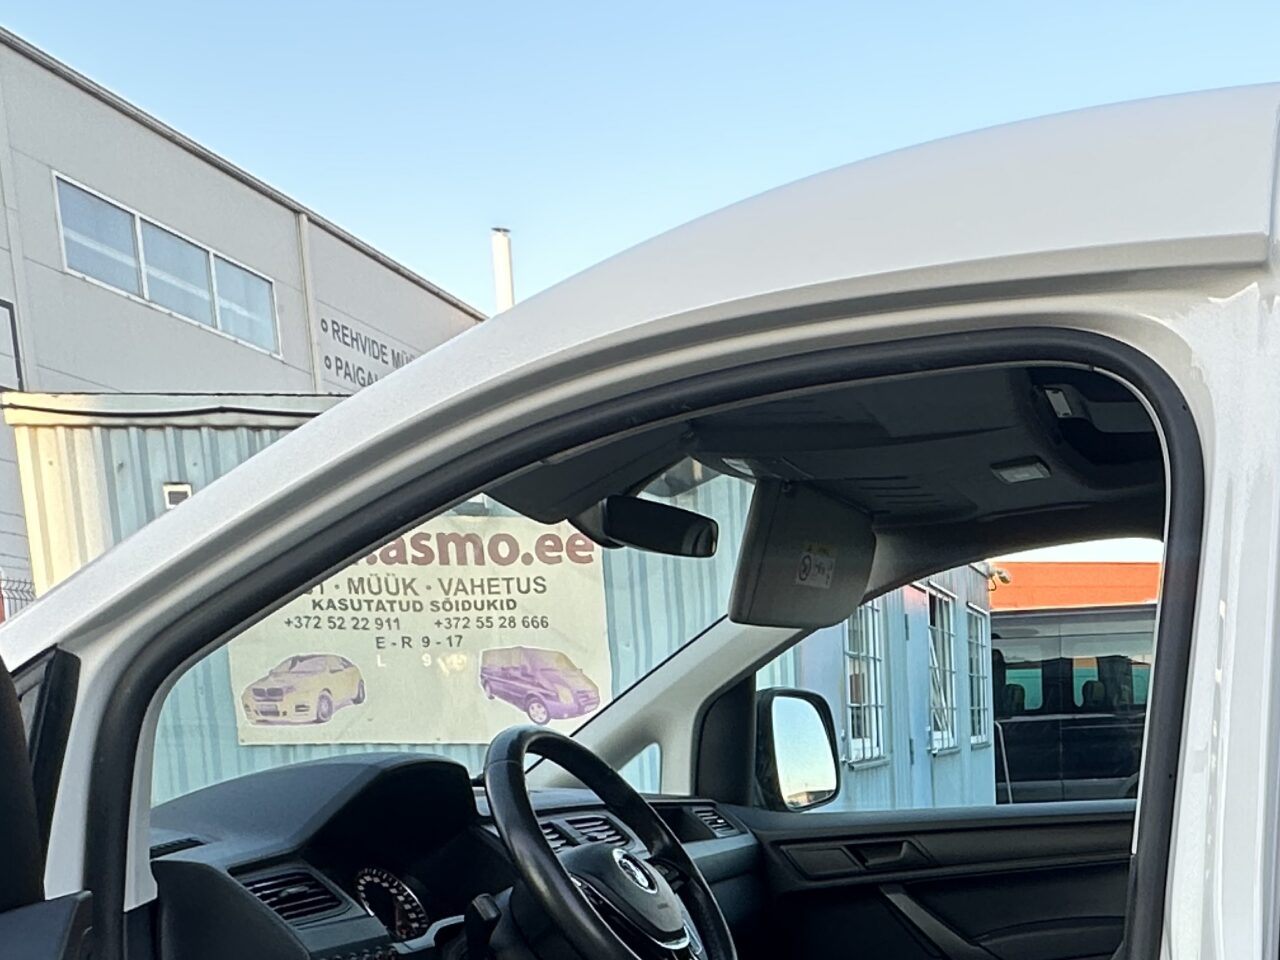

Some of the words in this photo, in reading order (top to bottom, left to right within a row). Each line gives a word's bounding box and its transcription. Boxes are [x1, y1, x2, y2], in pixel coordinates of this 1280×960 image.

[331, 320, 389, 365] REHVIDE
[353, 532, 595, 566] .asmo.ee
[347, 573, 419, 596] MÜÜK
[438, 576, 547, 596] VAHETUS
[312, 598, 424, 613] KASUTATUD
[430, 597, 517, 612] SÕIDUKID
[284, 615, 322, 629] +372
[327, 616, 347, 630] 52
[350, 617, 370, 631] 22
[374, 617, 400, 631] 911
[434, 616, 470, 629] +372
[475, 616, 494, 629] 55
[498, 615, 517, 629] 28
[521, 615, 549, 629] 666
[375, 636, 386, 650] E
[401, 635, 413, 649] R
[421, 635, 431, 648] 9
[445, 634, 463, 647] 17
